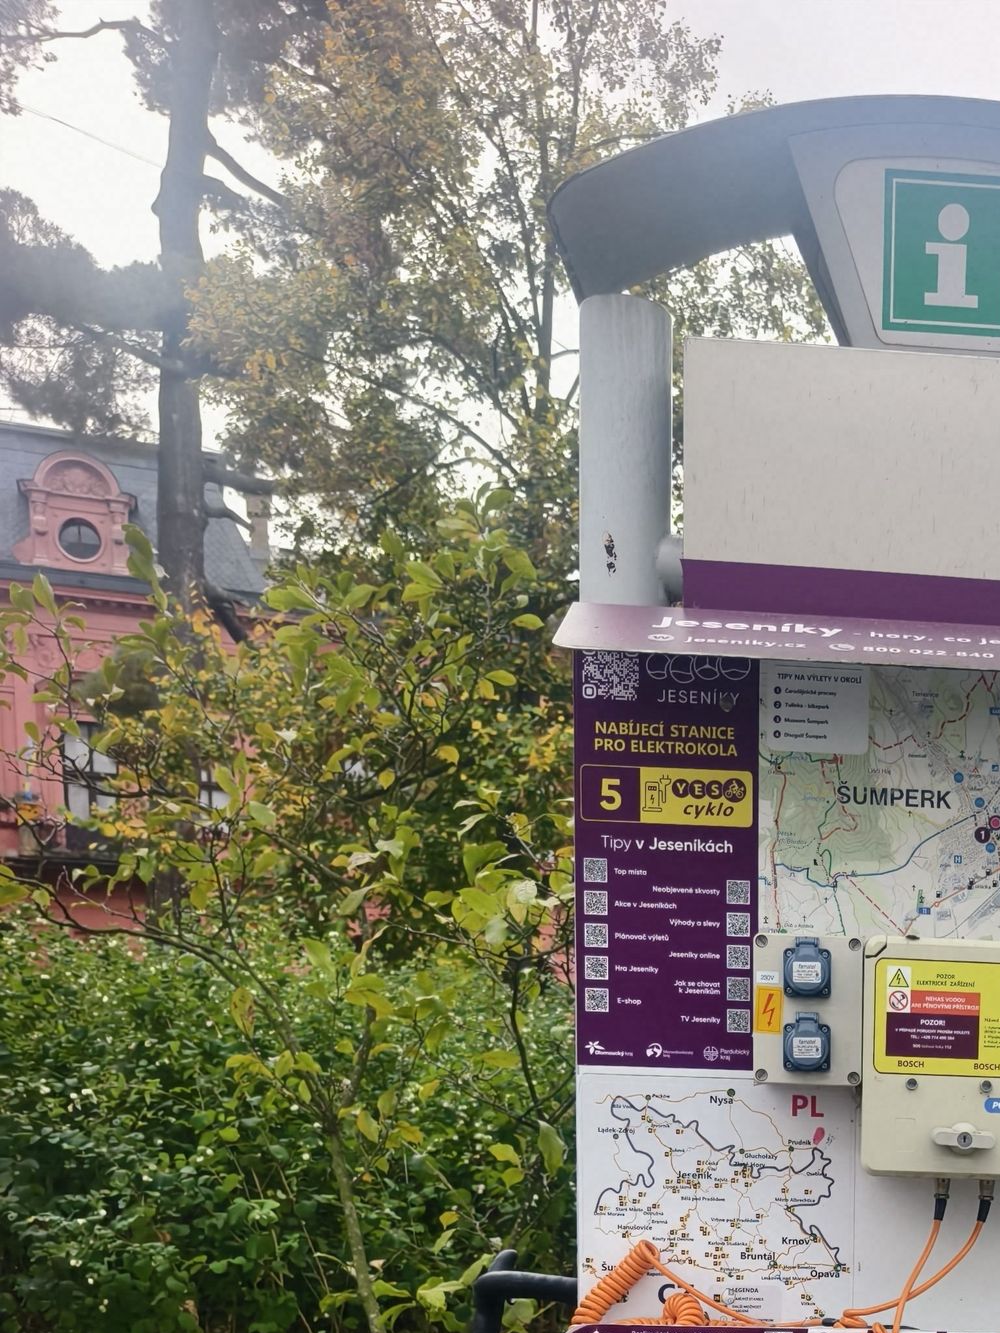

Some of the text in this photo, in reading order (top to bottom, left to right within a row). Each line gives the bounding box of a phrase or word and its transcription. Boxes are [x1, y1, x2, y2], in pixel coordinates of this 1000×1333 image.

[651, 616, 843, 638] Jeseníky
[909, 648, 947, 656] 022
[956, 651, 994, 659] 840
[807, 674, 832, 682] VÝLETY
[840, 676, 862, 684] OKOLÍ
[595, 720, 735, 740] NABÍJECÍ STANICE
[594, 738, 738, 757] PRO ELEKTROKOLA
[674, 781, 721, 798] YES
[600, 779, 622, 811] 5
[837, 781, 952, 809] ŠUMPERK
[683, 800, 735, 818] cyklo
[601, 835, 733, 853] Tipy v Jeseníkách
[614, 868, 647, 877] Top místa
[652, 886, 720, 896] Neobjevené skvosty
[639, 901, 677, 910] Jeseníkách
[669, 918, 695, 928] Výhody
[703, 919, 720, 928] slevy
[615, 932, 669, 942] Plánovač výletů
[669, 951, 698, 959] Jeseníky
[629, 965, 659, 974] Jeseníky
[674, 980, 686, 988] Jak
[696, 980, 720, 988] chovat
[684, 987, 720, 995] Jeseníkům
[617, 998, 642, 1006] E-shop
[692, 1016, 720, 1024] Jeseníky
[920, 1018, 946, 1027] POZOR!
[720, 1048, 749, 1056] Pardubický
[897, 1060, 925, 1068] BOSCH
[973, 1063, 1000, 1071] BOSCH
[709, 1096, 733, 1106] Nysa
[791, 1095, 824, 1118] PL
[676, 1170, 713, 1180] Jeseník
[781, 1236, 810, 1245] Krnov
[740, 1252, 776, 1261] Bruntál
[810, 1269, 840, 1279] Opava
